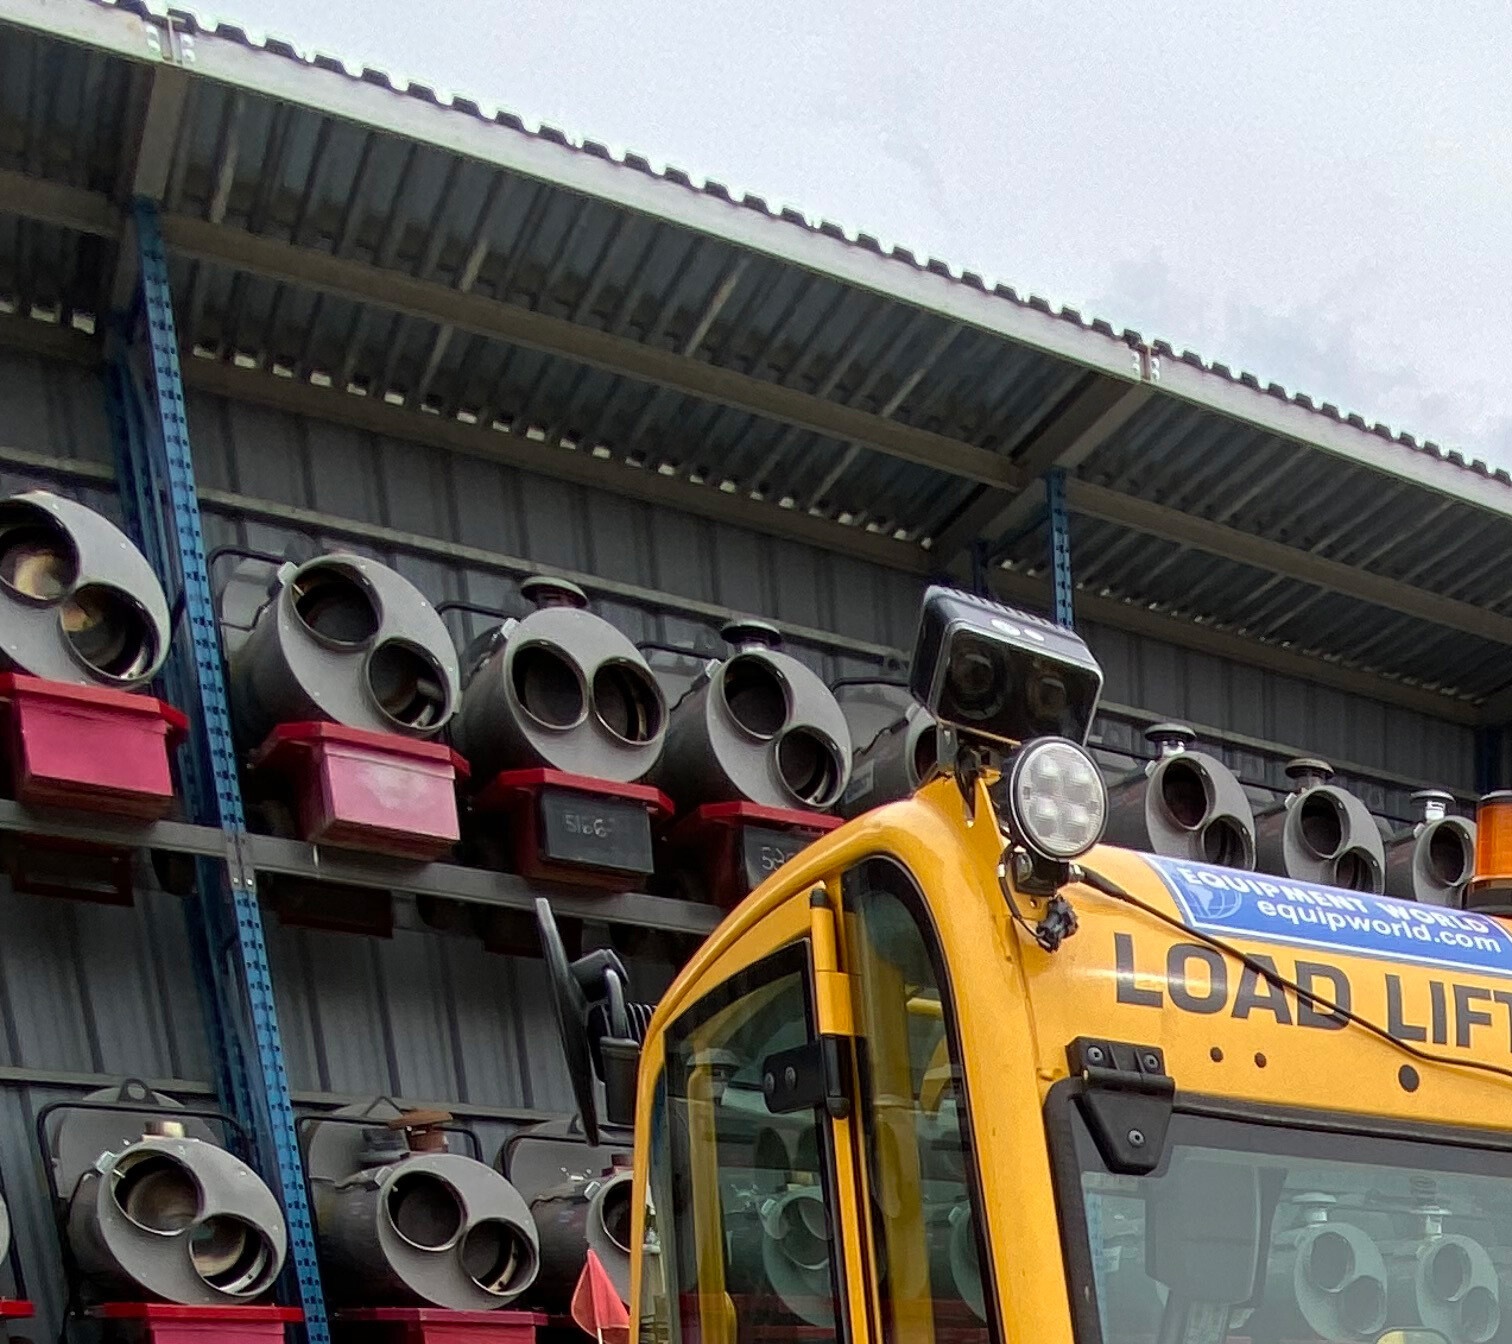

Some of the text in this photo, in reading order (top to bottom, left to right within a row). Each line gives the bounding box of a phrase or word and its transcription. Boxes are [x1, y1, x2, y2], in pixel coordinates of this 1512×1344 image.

[1177, 867, 1491, 935] EQUIPMENT WORLD
[1258, 899, 1502, 953] equipworld.com
[1113, 932, 1352, 1031] LOAD
